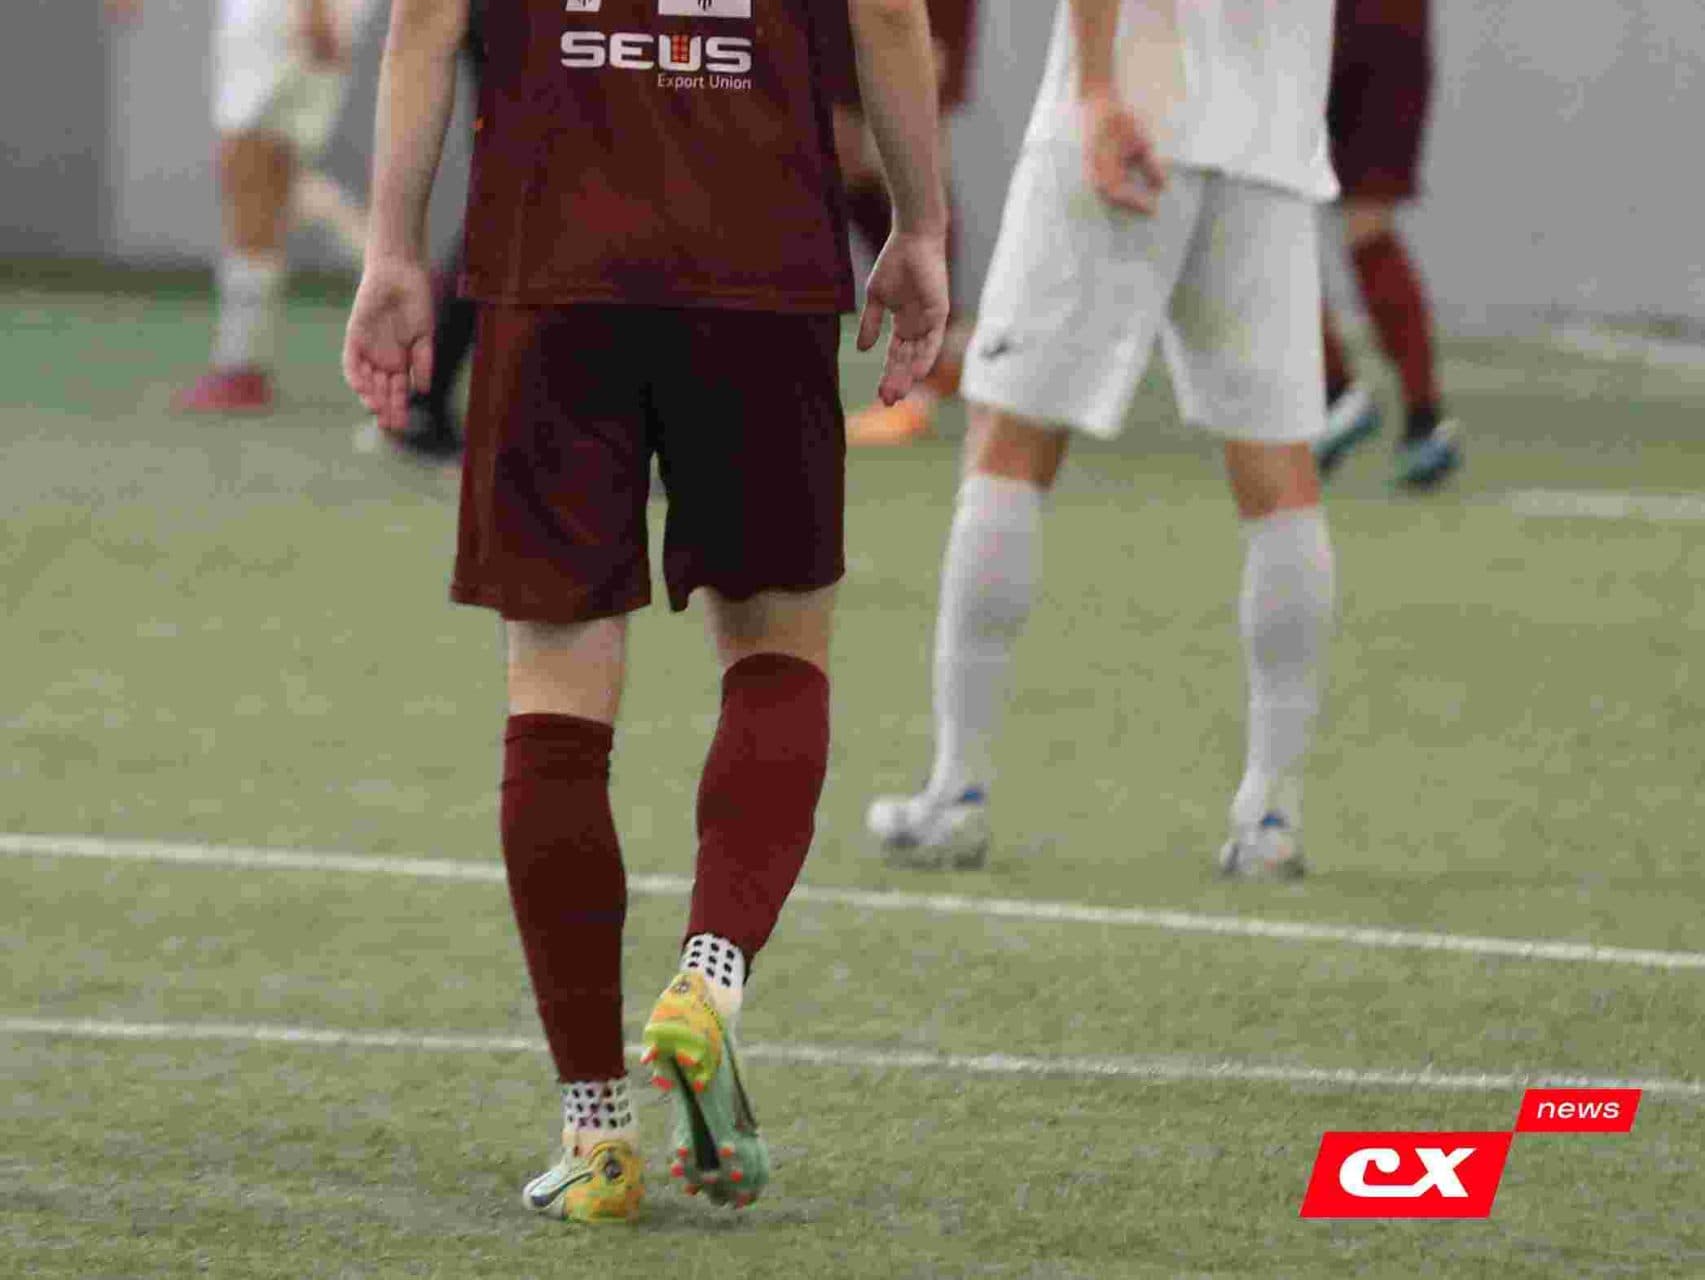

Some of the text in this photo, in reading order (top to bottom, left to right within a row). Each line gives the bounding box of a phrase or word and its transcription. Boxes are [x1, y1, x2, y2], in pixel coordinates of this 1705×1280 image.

[560, 31, 752, 73] SEUS
[657, 72, 752, 91] Export Union
